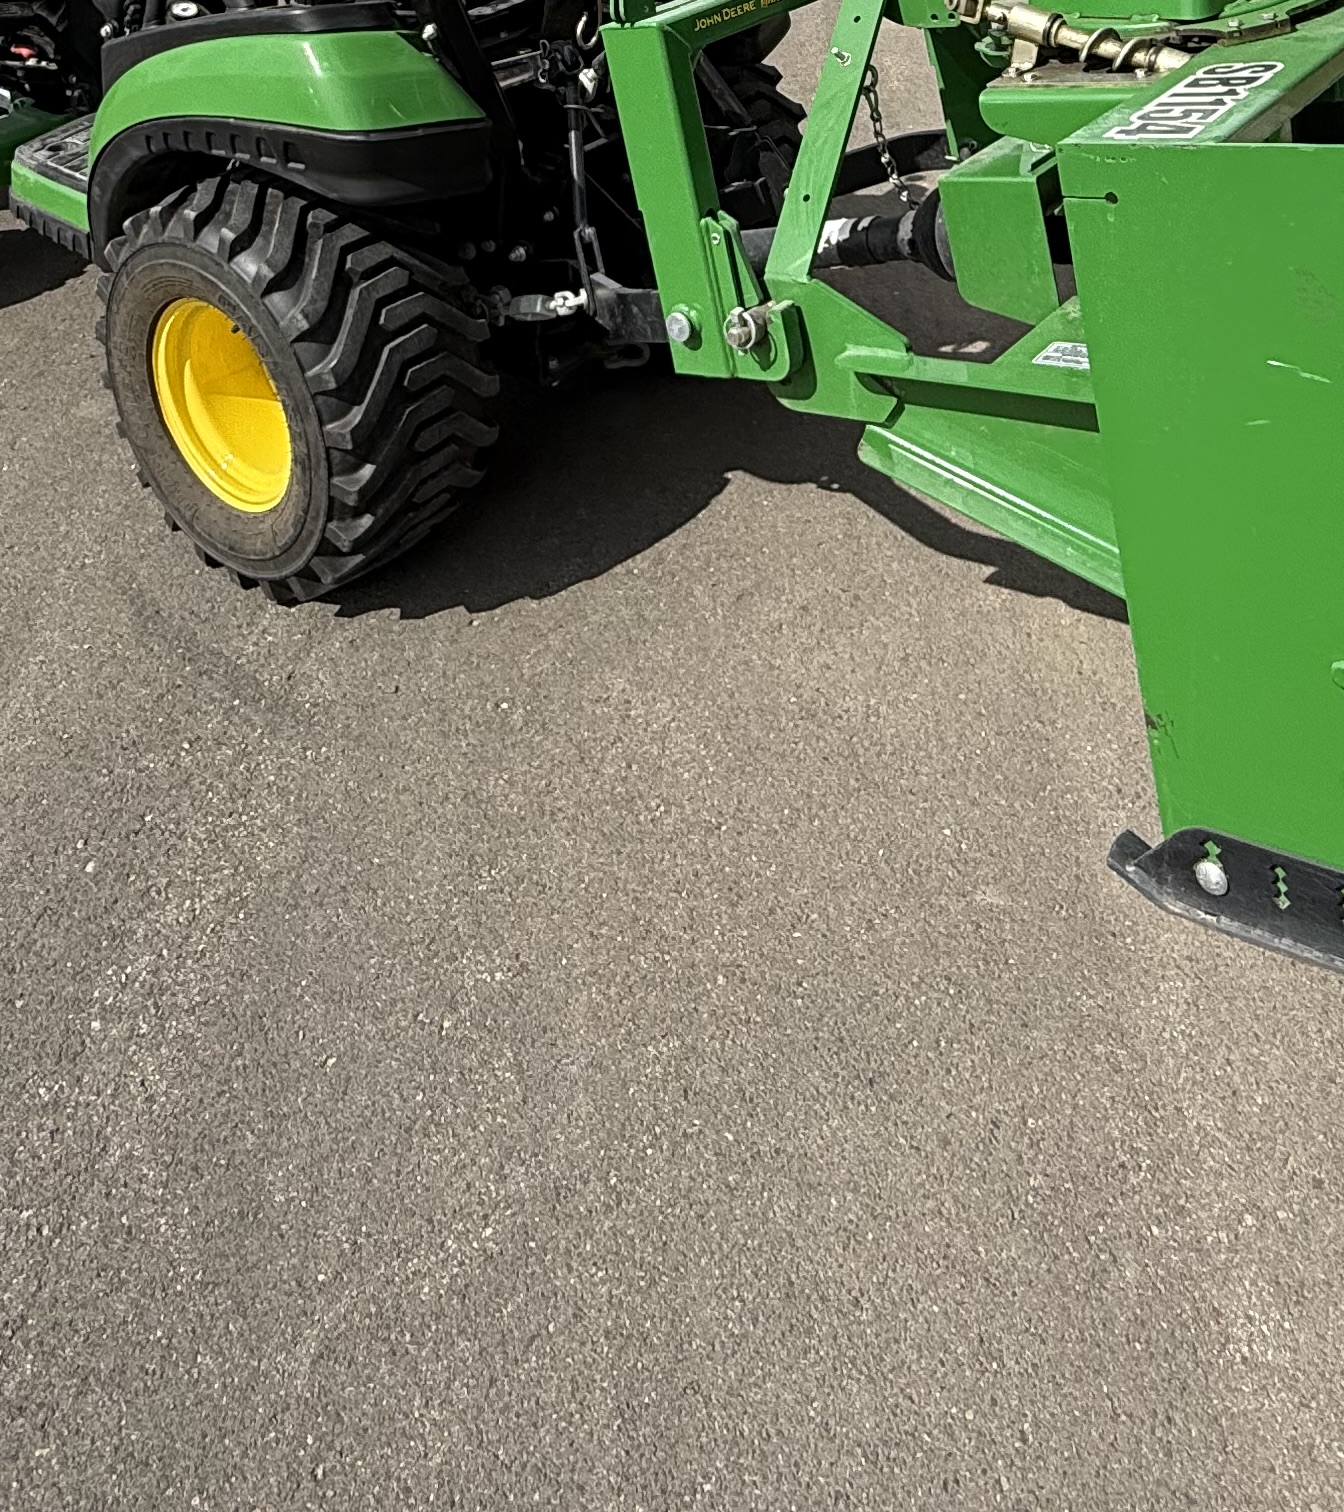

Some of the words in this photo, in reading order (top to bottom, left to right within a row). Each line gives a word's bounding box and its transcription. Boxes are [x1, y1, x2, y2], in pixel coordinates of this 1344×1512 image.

[694, 12, 722, 31] JOHN
[722, 0, 756, 20] DEERE
[1110, 62, 1282, 138] SB1154
